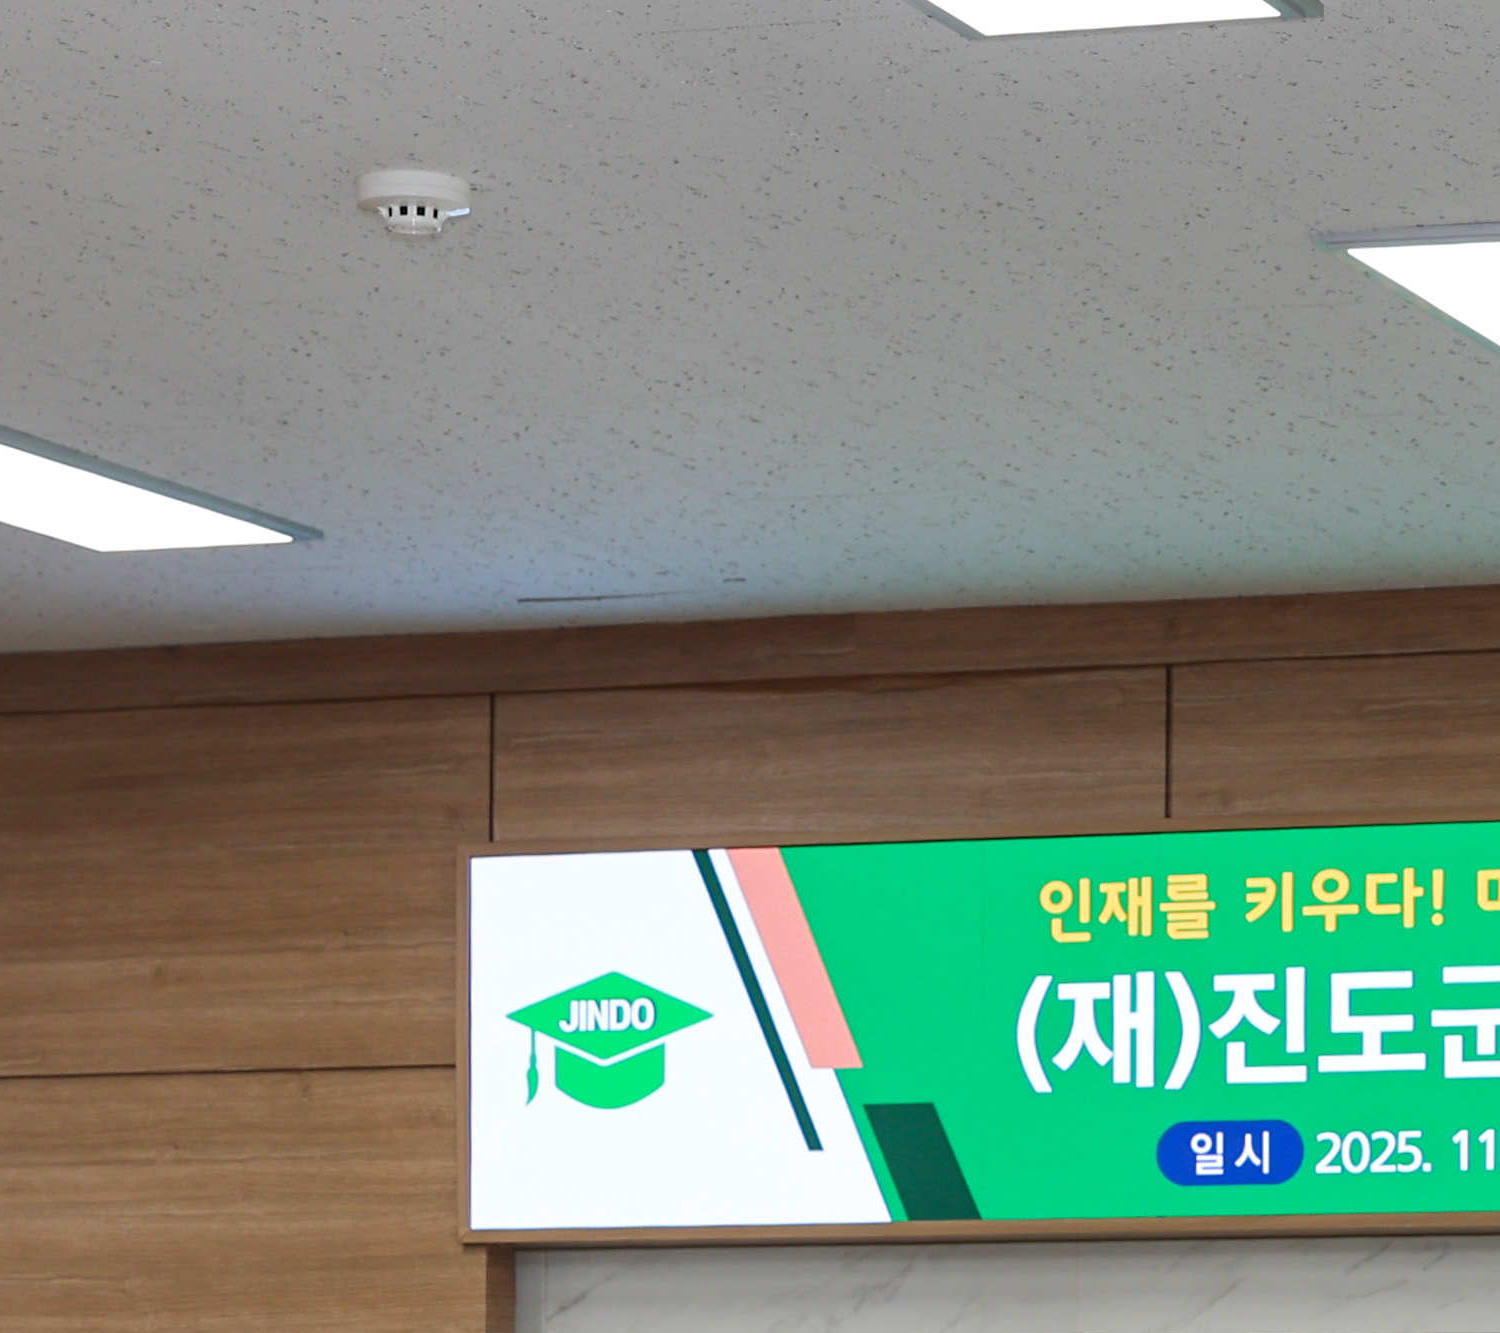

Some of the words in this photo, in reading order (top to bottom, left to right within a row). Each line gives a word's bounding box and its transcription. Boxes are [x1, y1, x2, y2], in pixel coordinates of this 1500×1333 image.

[1039, 872, 1217, 944] 인재를
[1245, 867, 1447, 934] 키우다!
[559, 997, 656, 1033] JINDO
[1189, 1130, 1272, 1177] 일시
[1314, 1129, 1433, 1175] 2025.
